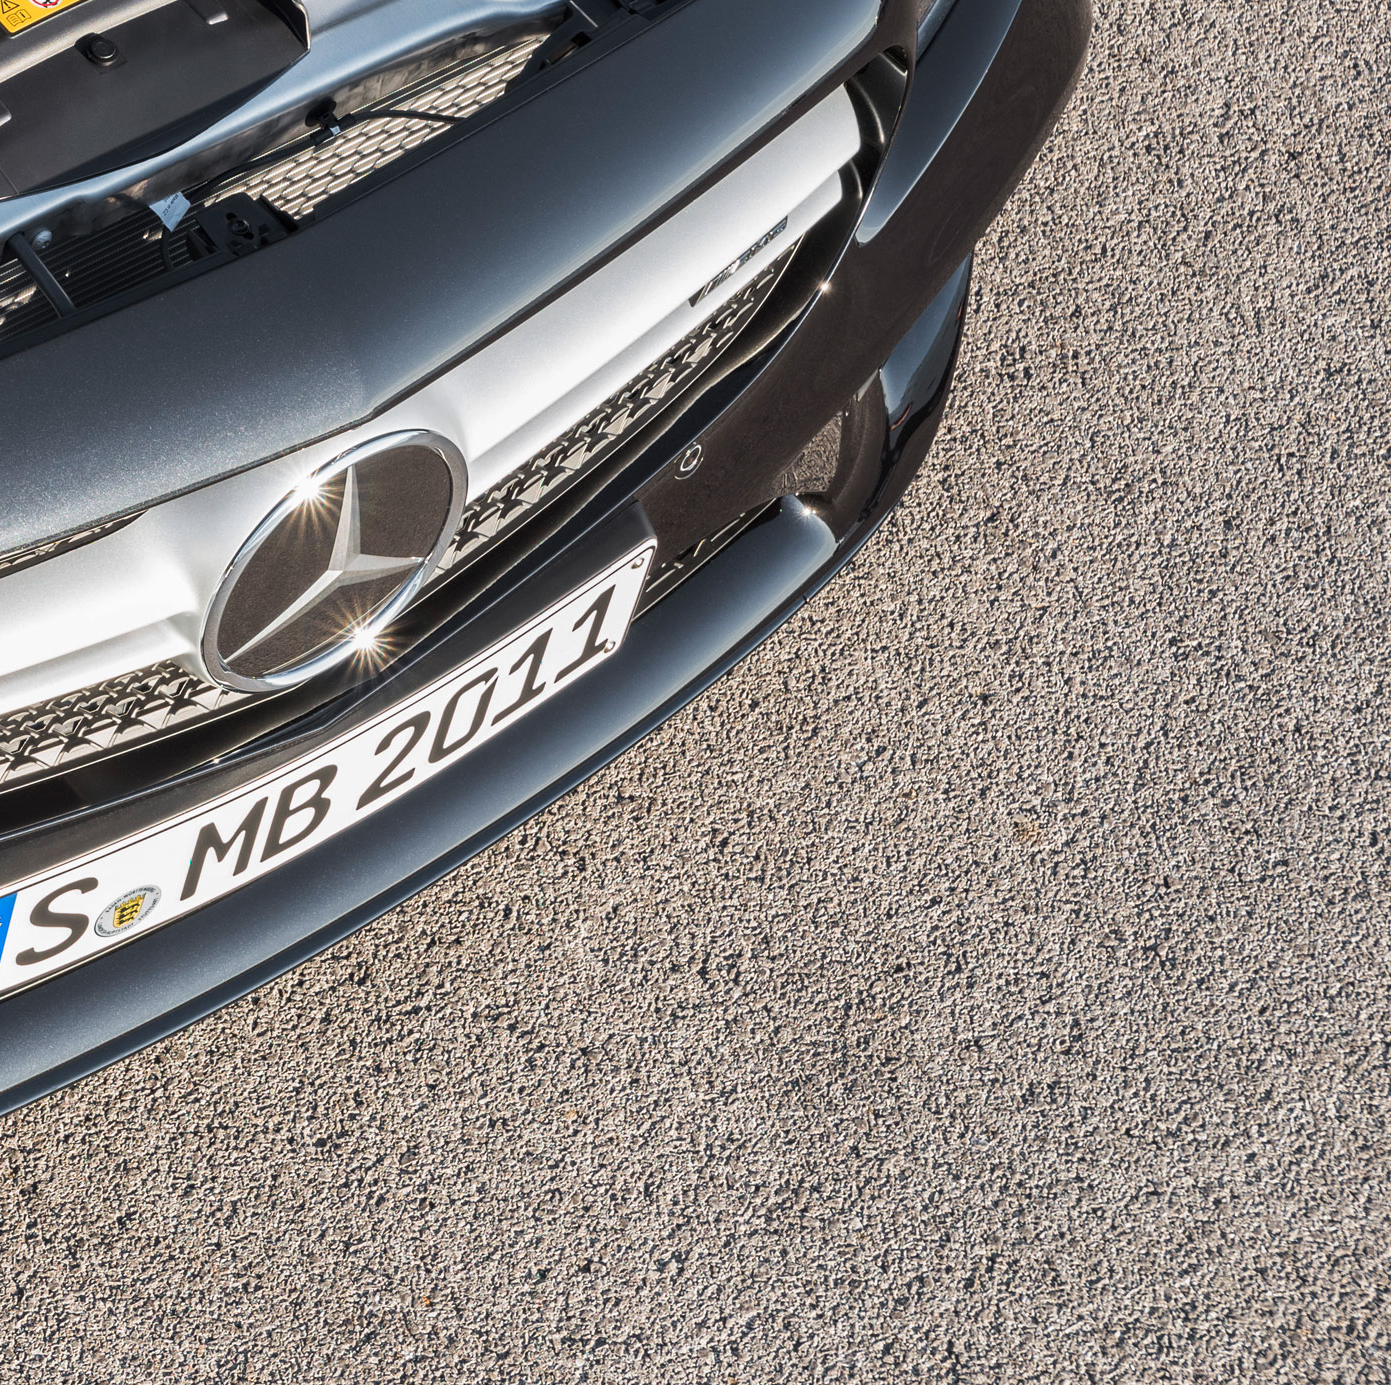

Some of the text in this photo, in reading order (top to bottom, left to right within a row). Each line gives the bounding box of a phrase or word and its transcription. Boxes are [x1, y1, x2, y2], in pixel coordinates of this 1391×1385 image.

[15, 583, 616, 966] S MB 2011
